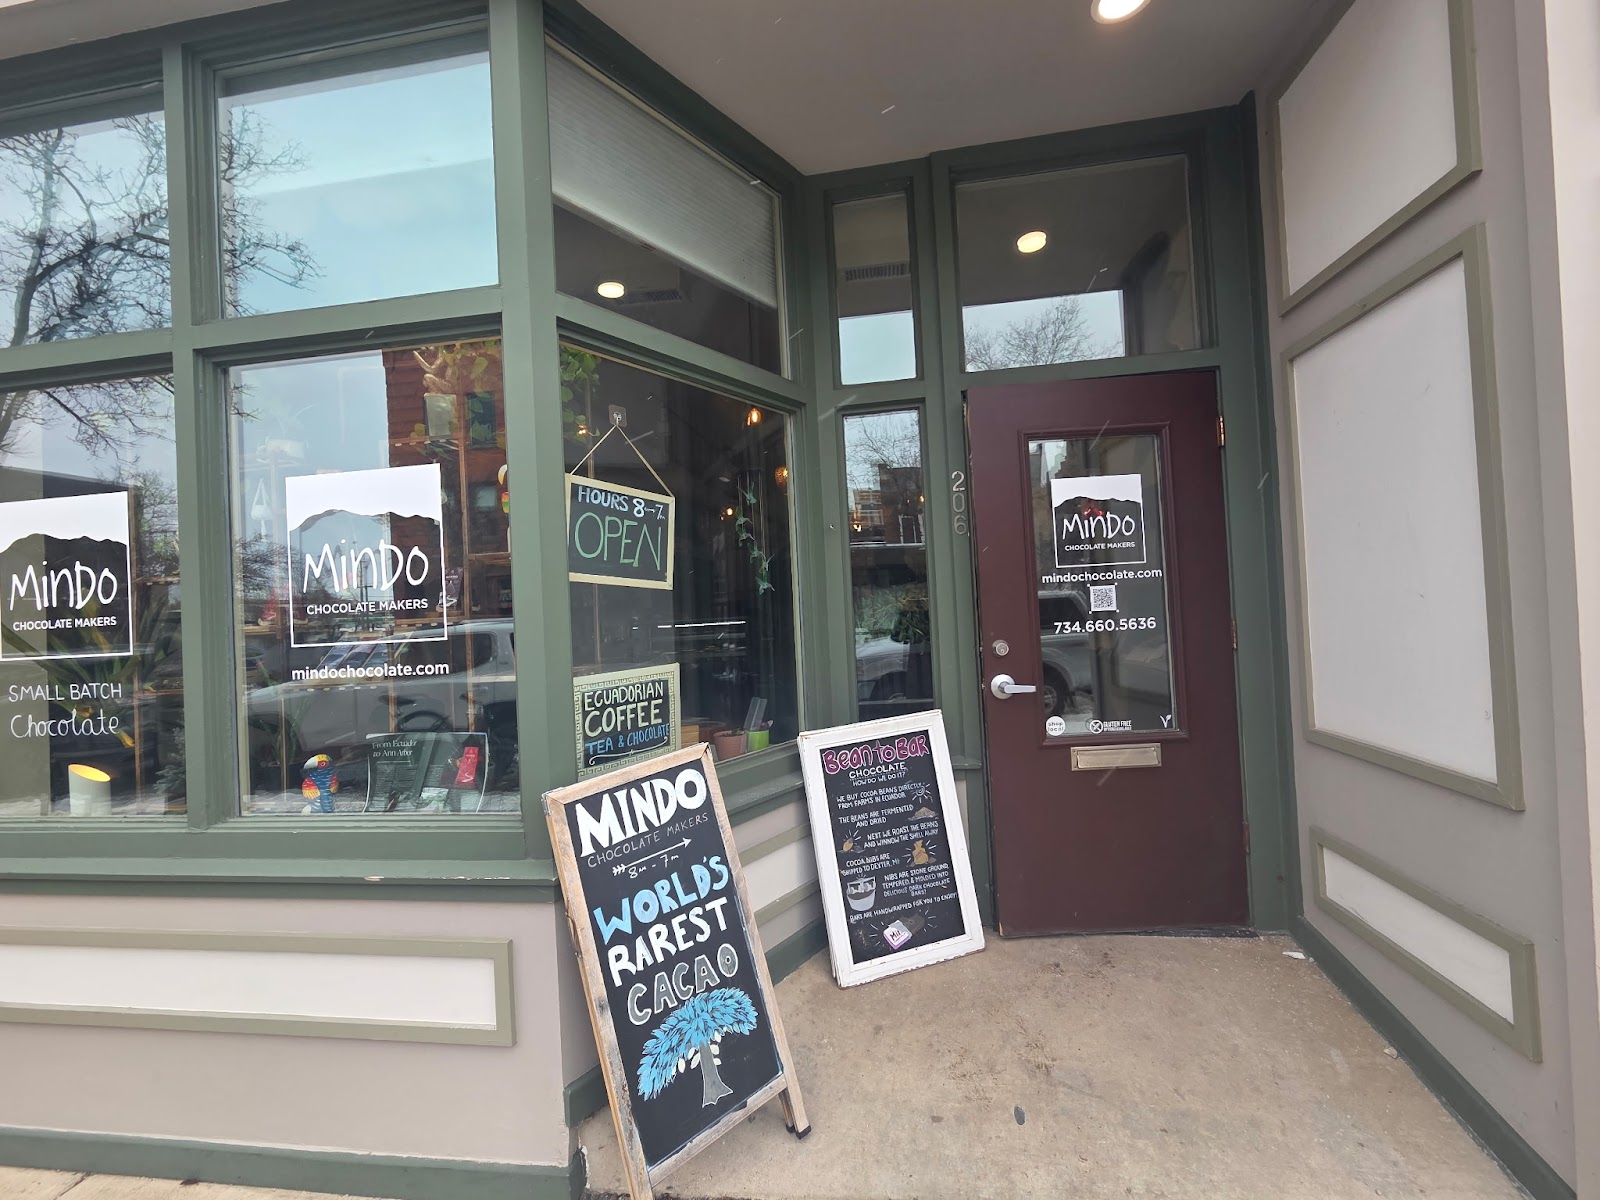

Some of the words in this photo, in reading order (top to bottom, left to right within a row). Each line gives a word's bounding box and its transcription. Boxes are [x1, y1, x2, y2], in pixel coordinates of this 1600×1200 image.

[578, 485, 629, 512] HOURS
[951, 470, 967, 535] 206
[574, 512, 662, 571] OPEN
[1064, 543, 1106, 551] CHOCOLATE
[1107, 541, 1136, 550] MAKERS
[1041, 568, 1163, 584] mindochocolate.com
[306, 602, 376, 616] CHOCOLATE
[379, 598, 429, 611] MAKERS
[13, 618, 73, 632] CHOCOLATE
[74, 616, 118, 628] MAKERS
[1053, 617, 1157, 634] 734.660.5636
[291, 661, 450, 682] mindochocolate.com
[8, 684, 65, 703] SMALL
[69, 683, 122, 700] BATCH
[584, 682, 664, 711] ECUADORIAN
[10, 707, 120, 739] Chocolate
[584, 699, 663, 738] COFFEE
[584, 737, 614, 755] TEA
[618, 735, 625, 748] &
[627, 723, 670, 747] CHOCOLATE
[822, 745, 875, 774] Bean
[872, 740, 896, 763] to
[849, 762, 907, 779] CHOCOLATE
[852, 778, 867, 787] HOW
[887, 773, 896, 781] DO
[846, 792, 859, 800] BUY
[860, 790, 879, 798] COCOA
[878, 785, 898, 795] BEANS
[575, 768, 707, 858] MINDO
[838, 801, 853, 810] FROM
[854, 798, 874, 808] FARMS
[838, 816, 850, 824] THE
[850, 813, 869, 823] BEANS
[869, 810, 880, 818] ARE
[587, 830, 661, 868] CHOCOLATE
[666, 812, 709, 837] MAKERS
[864, 841, 876, 849] AND
[876, 836, 900, 847] WINNOW
[867, 831, 881, 841] NEXT
[892, 825, 909, 836] ROAST
[879, 852, 890, 860] ARE
[862, 864, 871, 872] TO
[884, 872, 898, 881] NIBS
[898, 870, 910, 879] ARE
[593, 855, 729, 945] WORLD'S
[863, 911, 873, 919] ARE
[934, 895, 941, 903] TO
[607, 897, 728, 987] RAREST
[627, 943, 739, 1026] CACAO
